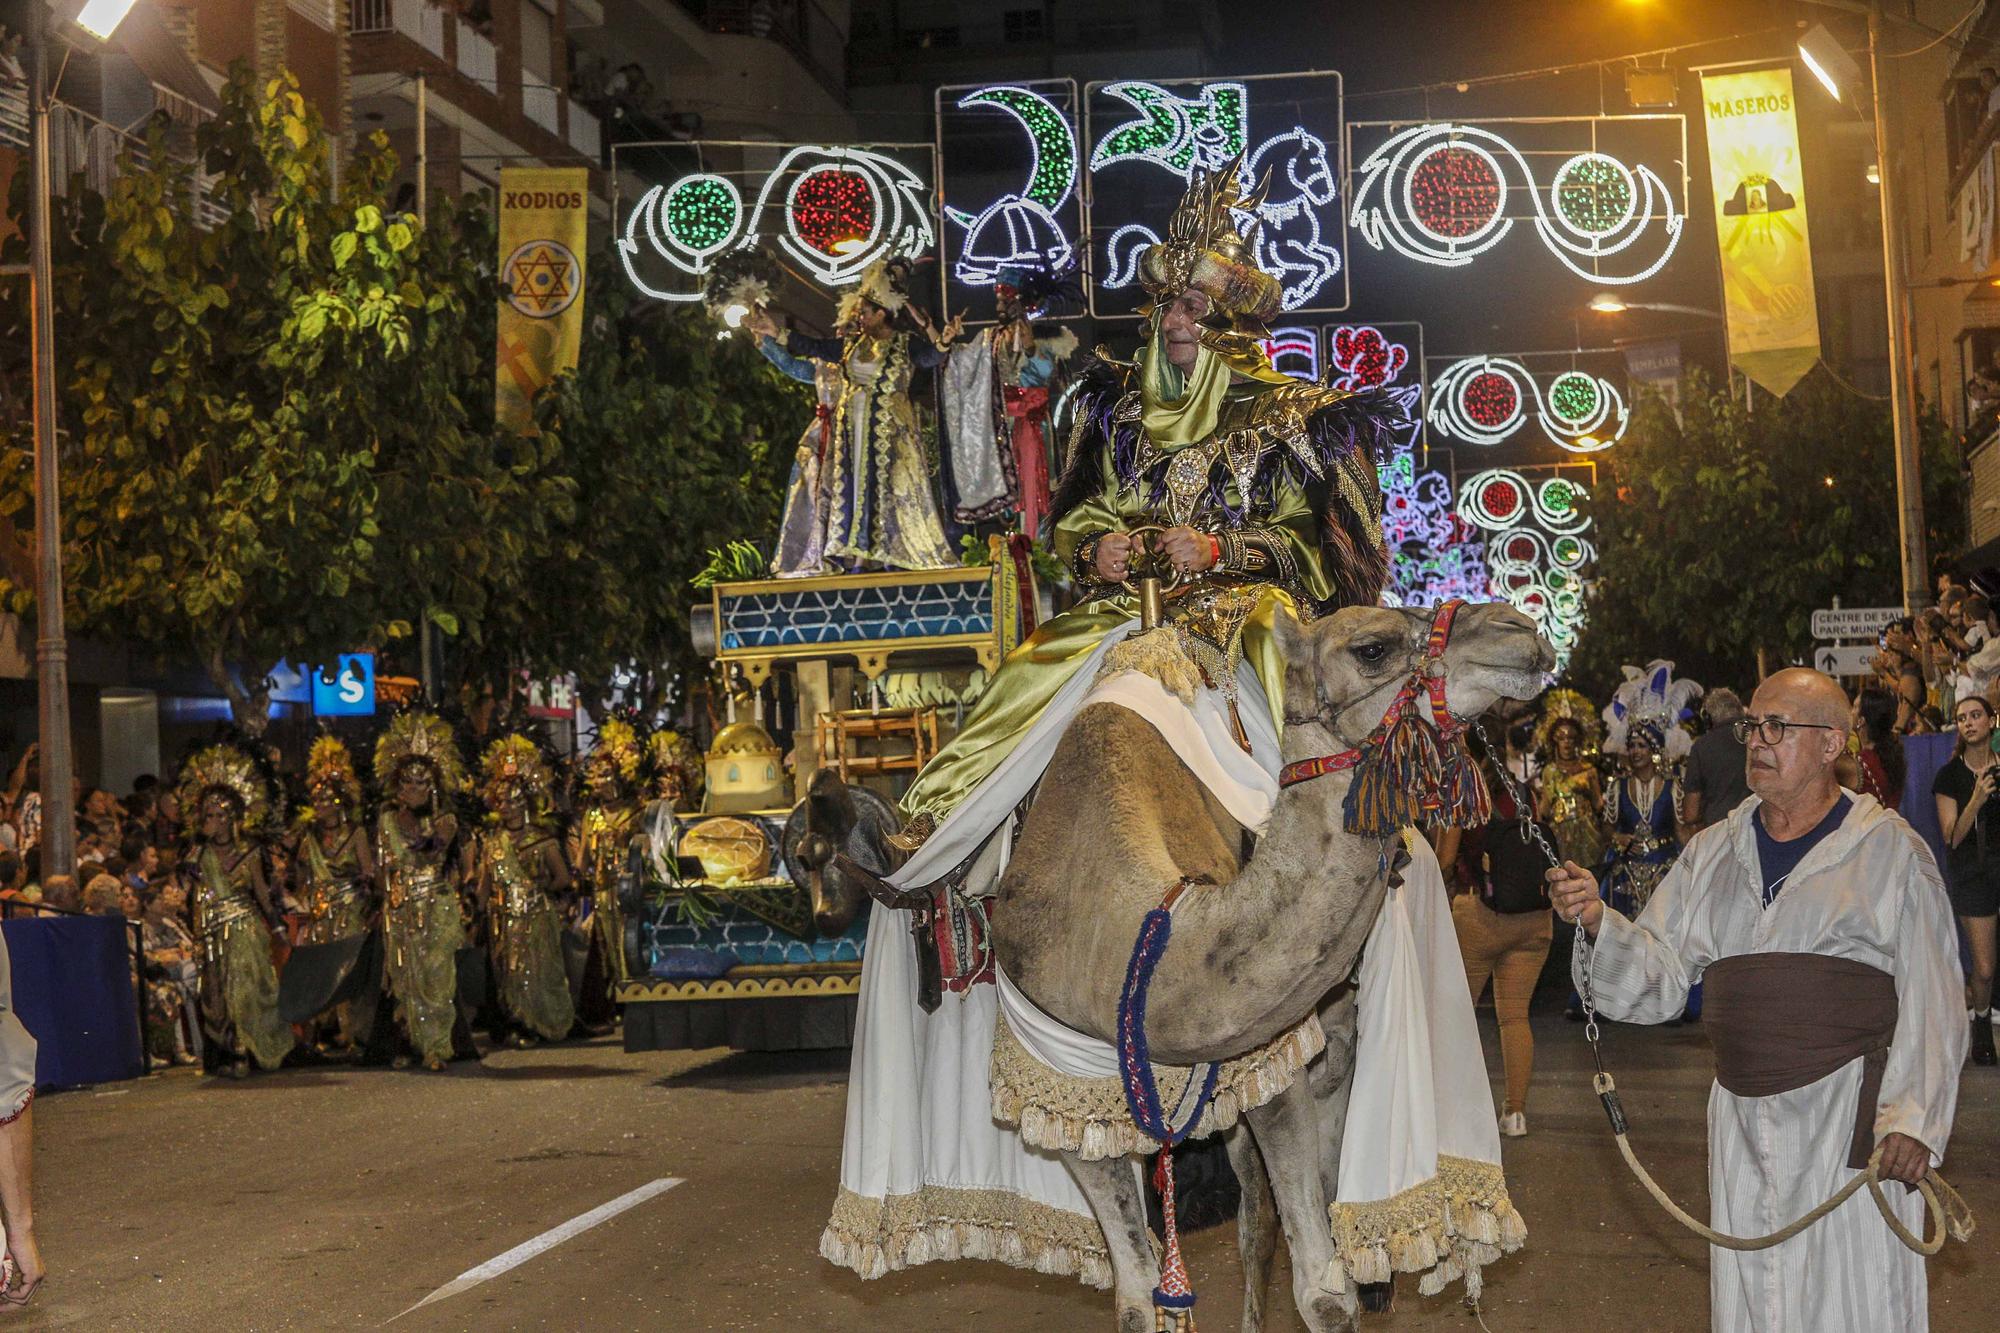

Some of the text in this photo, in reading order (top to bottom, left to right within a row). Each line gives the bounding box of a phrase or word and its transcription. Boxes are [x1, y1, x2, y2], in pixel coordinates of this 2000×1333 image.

[1708, 94, 1790, 119] MASEROS
[505, 191, 583, 209] XODIOS
[1819, 612, 1860, 623] CENTRE
[1864, 612, 1878, 622] DE
[1819, 624, 1848, 635] PARC
